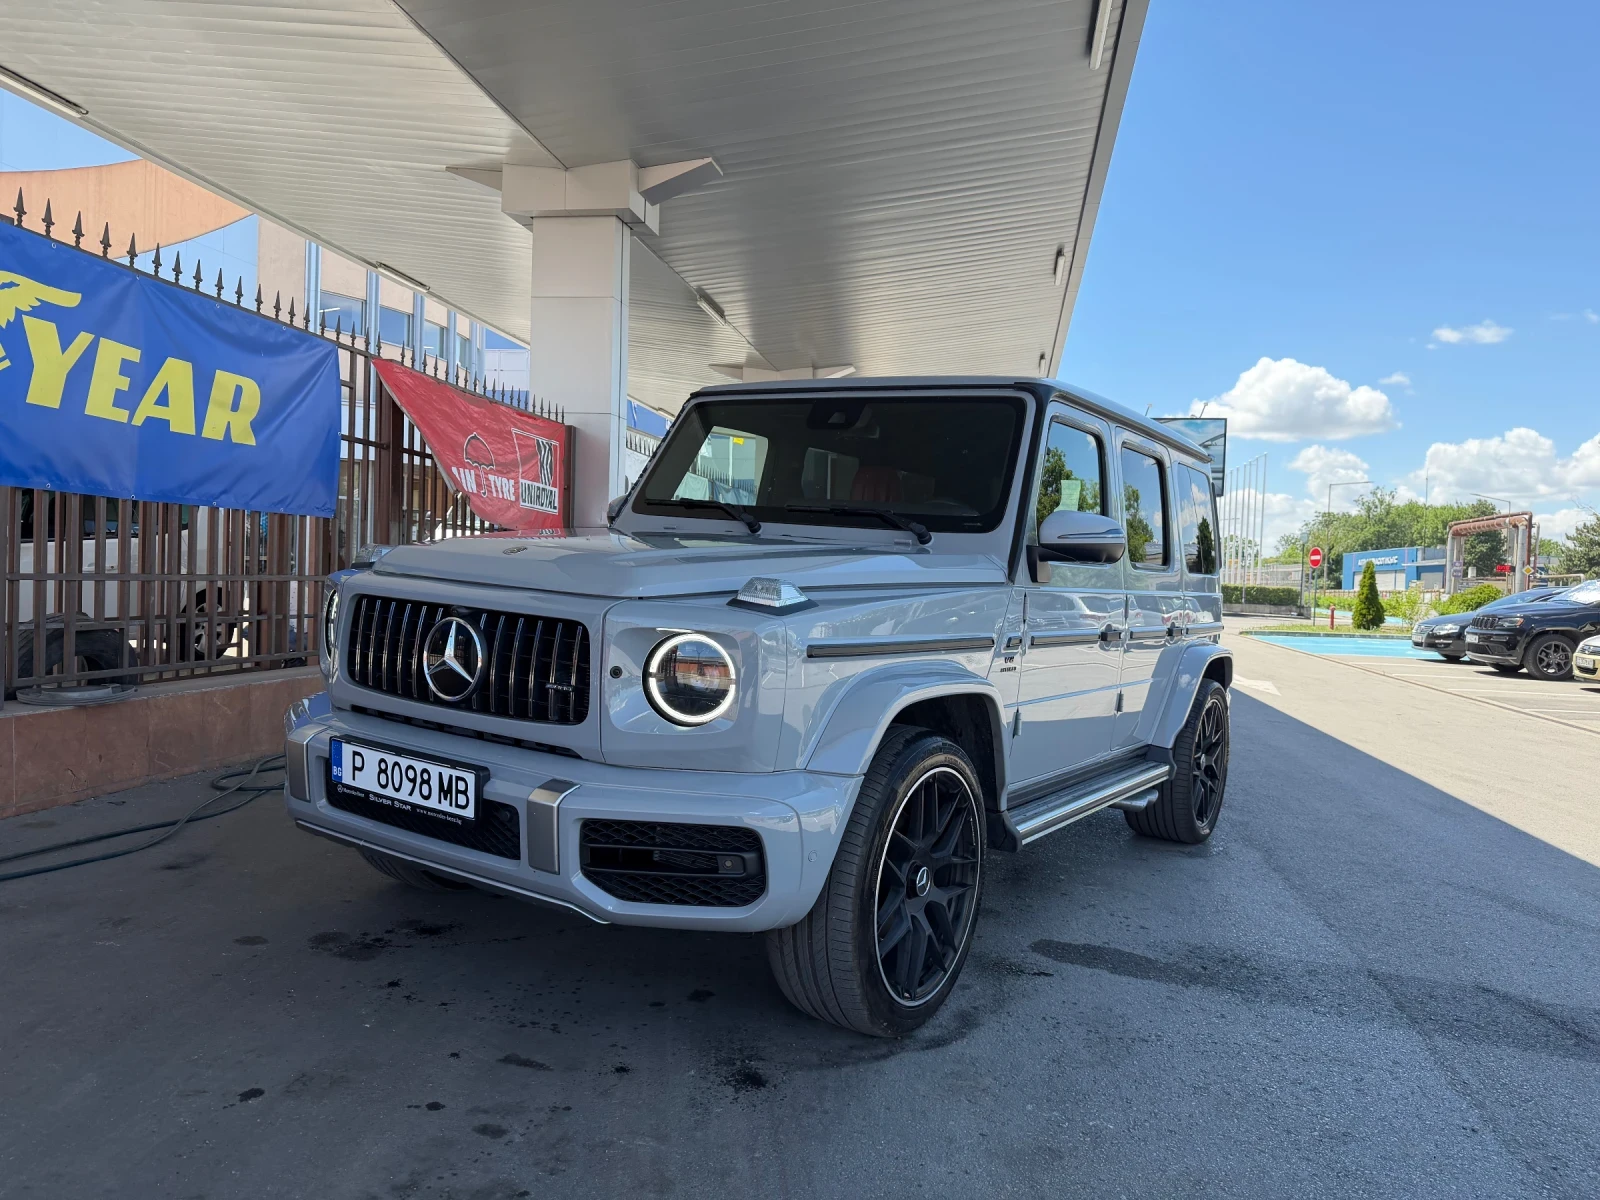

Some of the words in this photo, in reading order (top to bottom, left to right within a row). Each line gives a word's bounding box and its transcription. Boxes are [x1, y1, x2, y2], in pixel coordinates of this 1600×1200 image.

[22, 315, 261, 446] YEAR
[488, 474, 516, 501] TYRE
[520, 482, 558, 510] UNIROYAL
[333, 766, 342, 777] BG
[352, 750, 365, 781] P
[377, 757, 432, 801] 8098
[438, 771, 470, 810] MB
[394, 800, 412, 812] STAR
